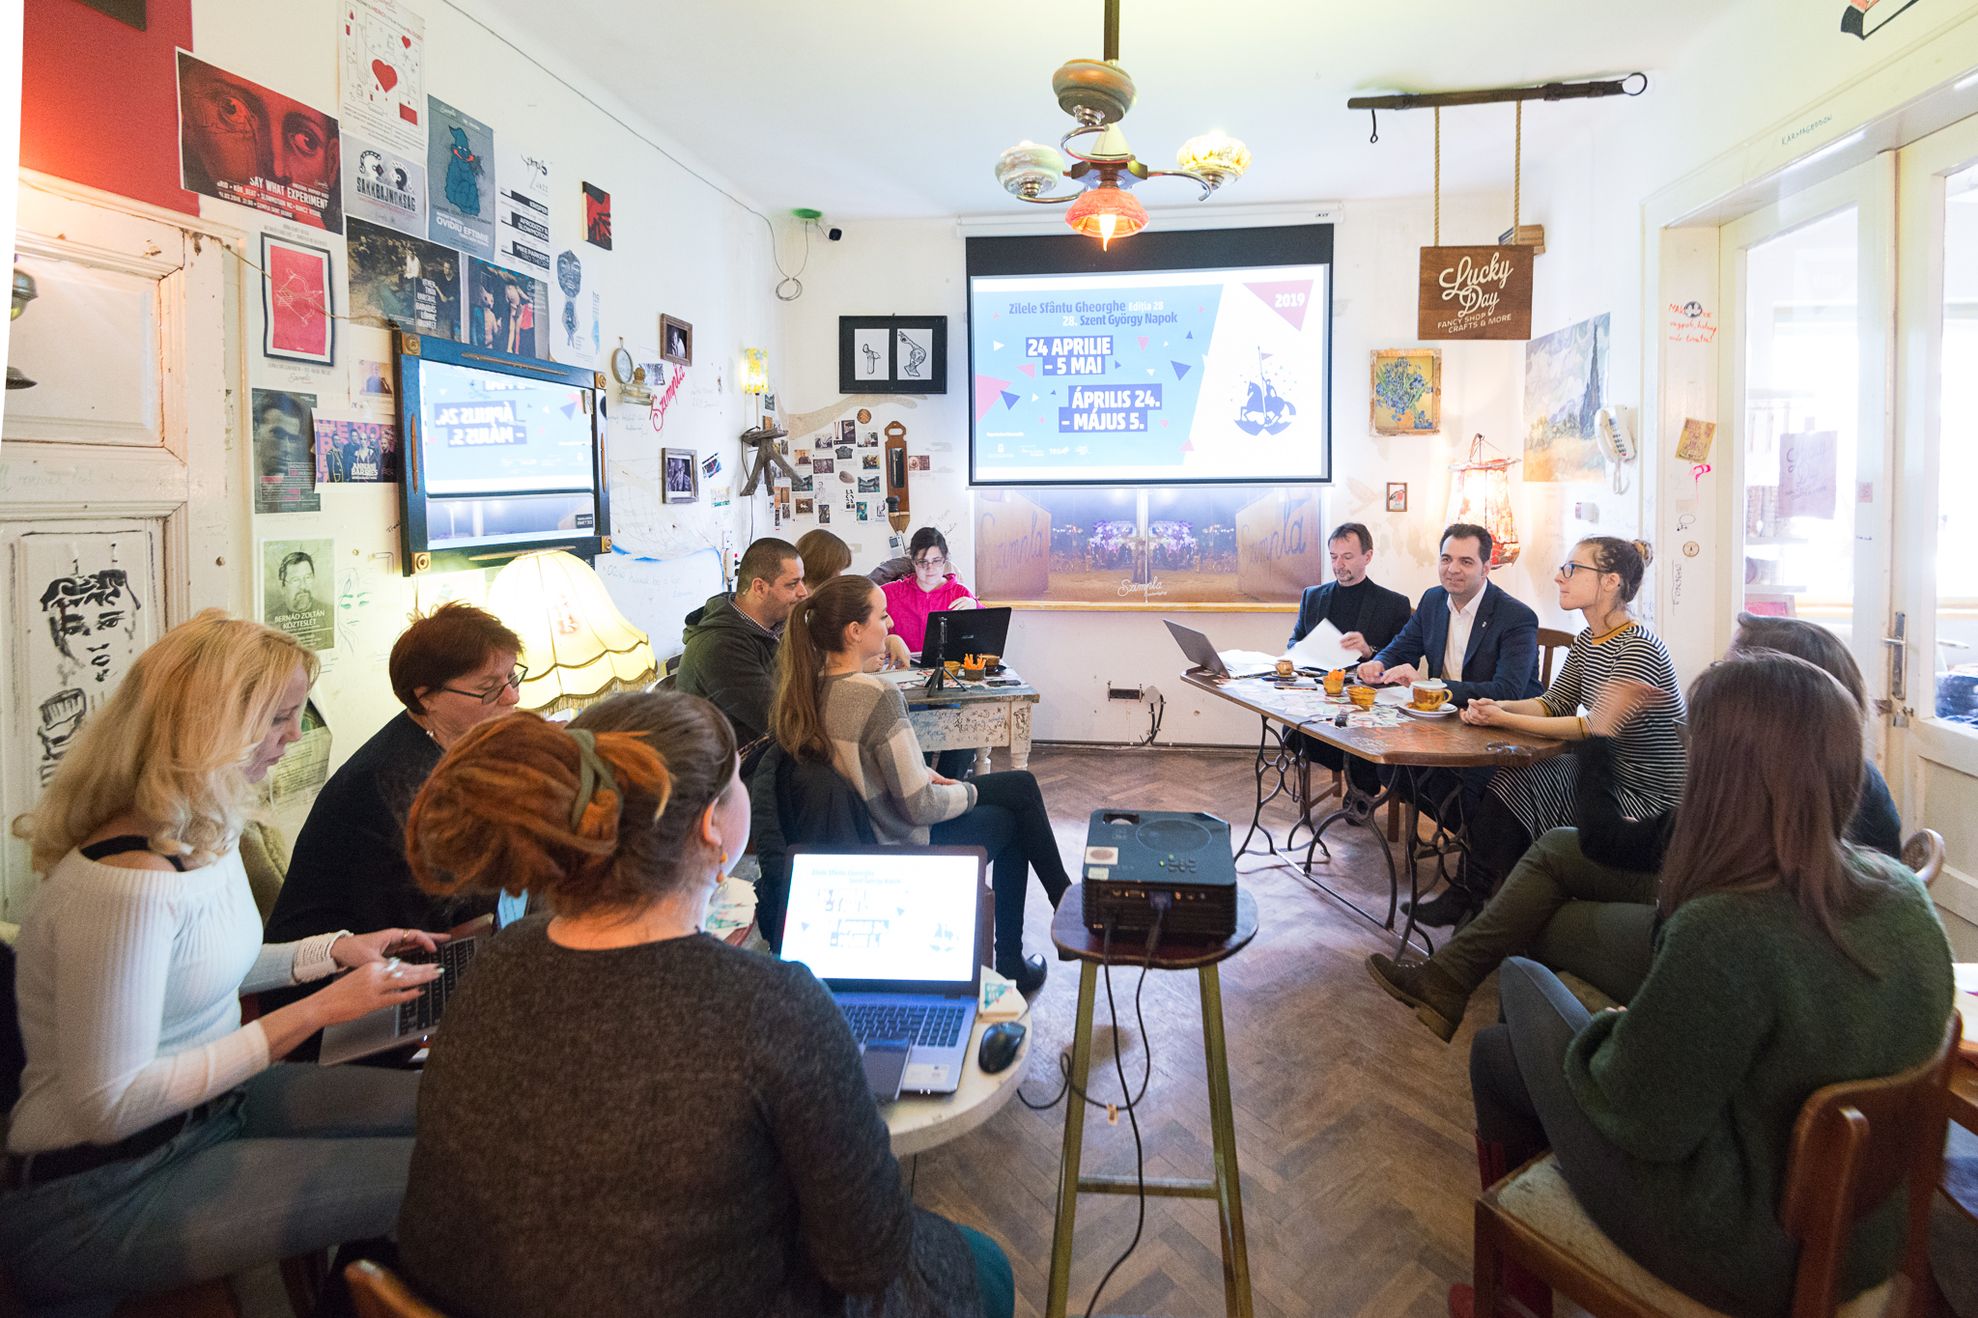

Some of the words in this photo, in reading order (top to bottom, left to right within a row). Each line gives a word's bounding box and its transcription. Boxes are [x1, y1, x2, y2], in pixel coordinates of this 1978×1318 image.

[250, 176, 264, 189] SAY
[265, 179, 285, 196] WHAT
[287, 186, 328, 210] EXPERIMENT
[436, 215, 463, 233] OVIDIU
[1439, 252, 1514, 300] Lucky
[1009, 302, 1037, 314] Zilele
[1040, 301, 1073, 314] Sfântu
[1075, 300, 1126, 314] Gheorghe
[1153, 301, 1164, 311] 28
[1275, 293, 1305, 308] 2019
[1458, 285, 1500, 318] Day
[1062, 316, 1077, 326] 28.
[1080, 315, 1106, 326] Szent
[1108, 313, 1143, 328] György
[1145, 312, 1178, 326] Napok
[1438, 318, 1463, 329] FANCY
[1465, 313, 1486, 323] SHOP
[1449, 321, 1478, 334] CRAFTS
[1488, 314, 1512, 325] MORE
[1027, 338, 1048, 356] 24
[1051, 337, 1112, 355] APRILIE
[1057, 357, 1067, 374] 5
[1071, 356, 1102, 374] MAI
[1072, 386, 1131, 409] ÁPRILIS
[1135, 390, 1160, 408] 24.
[1073, 410, 1126, 431] MÁJUS
[1130, 412, 1144, 430] 5.
